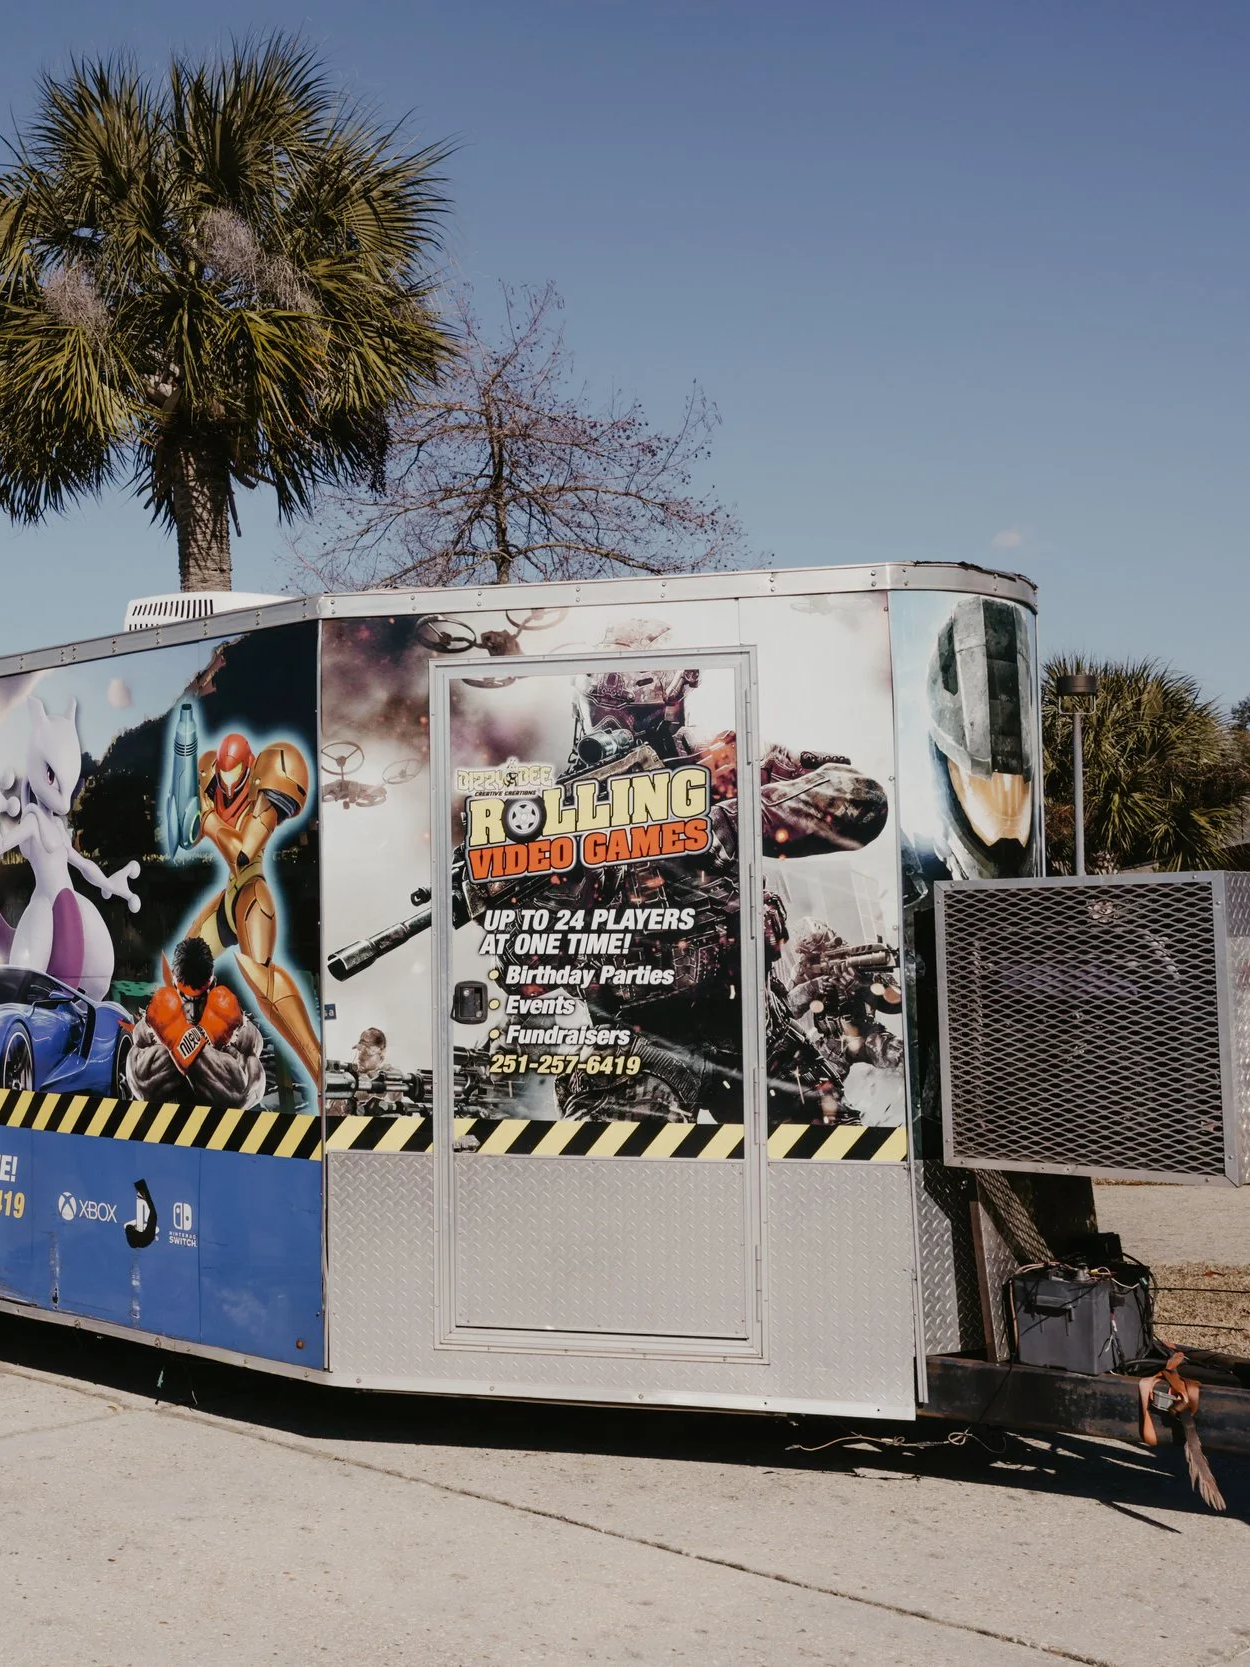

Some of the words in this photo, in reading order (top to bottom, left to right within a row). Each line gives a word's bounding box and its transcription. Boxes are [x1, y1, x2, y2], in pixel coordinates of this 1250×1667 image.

[457, 768, 505, 792] DIZZY
[469, 769, 707, 848] ROLLING
[468, 836, 574, 880] VIDEO
[583, 819, 709, 865] GAMES
[483, 909, 515, 931] UP
[521, 909, 549, 931] TO
[554, 909, 585, 931] 24
[591, 908, 696, 931] PLAYERS
[479, 933, 510, 955] AT
[514, 933, 561, 955] ONE
[567, 933, 632, 955] TIME!
[505, 965, 595, 988] Birthday
[599, 965, 675, 985] Parties
[505, 995, 575, 1015] Events
[505, 1025, 631, 1045] Fundraisers
[489, 1054, 641, 1075] 251-257-6419
[79, 1200, 118, 1224] XBOX
[169, 1231, 197, 1239] NINTENDO
[169, 1236, 197, 1247] SWITCH
